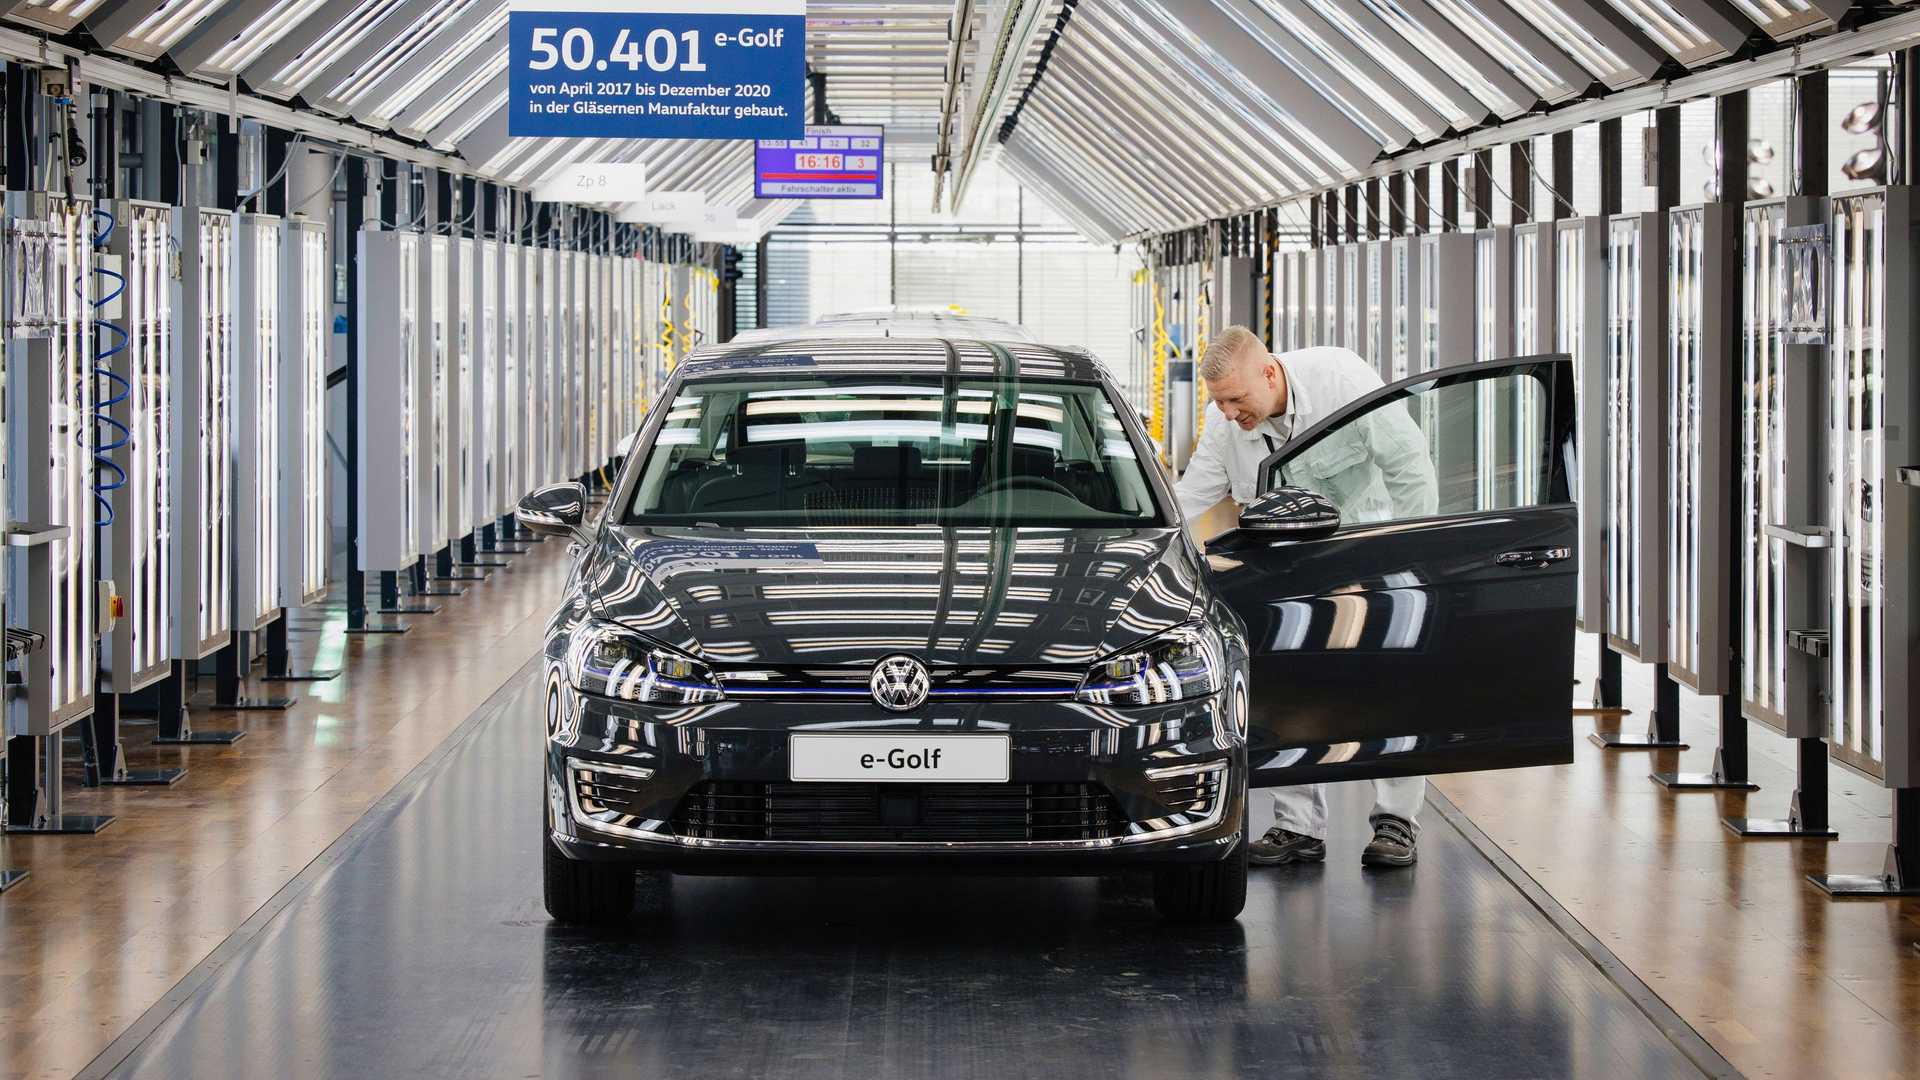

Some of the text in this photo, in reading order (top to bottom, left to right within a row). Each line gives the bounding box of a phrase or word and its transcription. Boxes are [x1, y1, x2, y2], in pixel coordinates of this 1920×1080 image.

[529, 28, 783, 72] 50.401 e-Golf
[530, 82, 770, 97] von April 2017 bis Dezember 2020
[530, 101, 788, 119] in der Gläsernen Manufaktur gebaut.
[799, 155, 840, 168] 16:16
[858, 158, 865, 168] 3
[576, 175, 608, 188] Zp 8
[836, 184, 857, 193] aktiv
[860, 748, 942, 769] e-Golf
